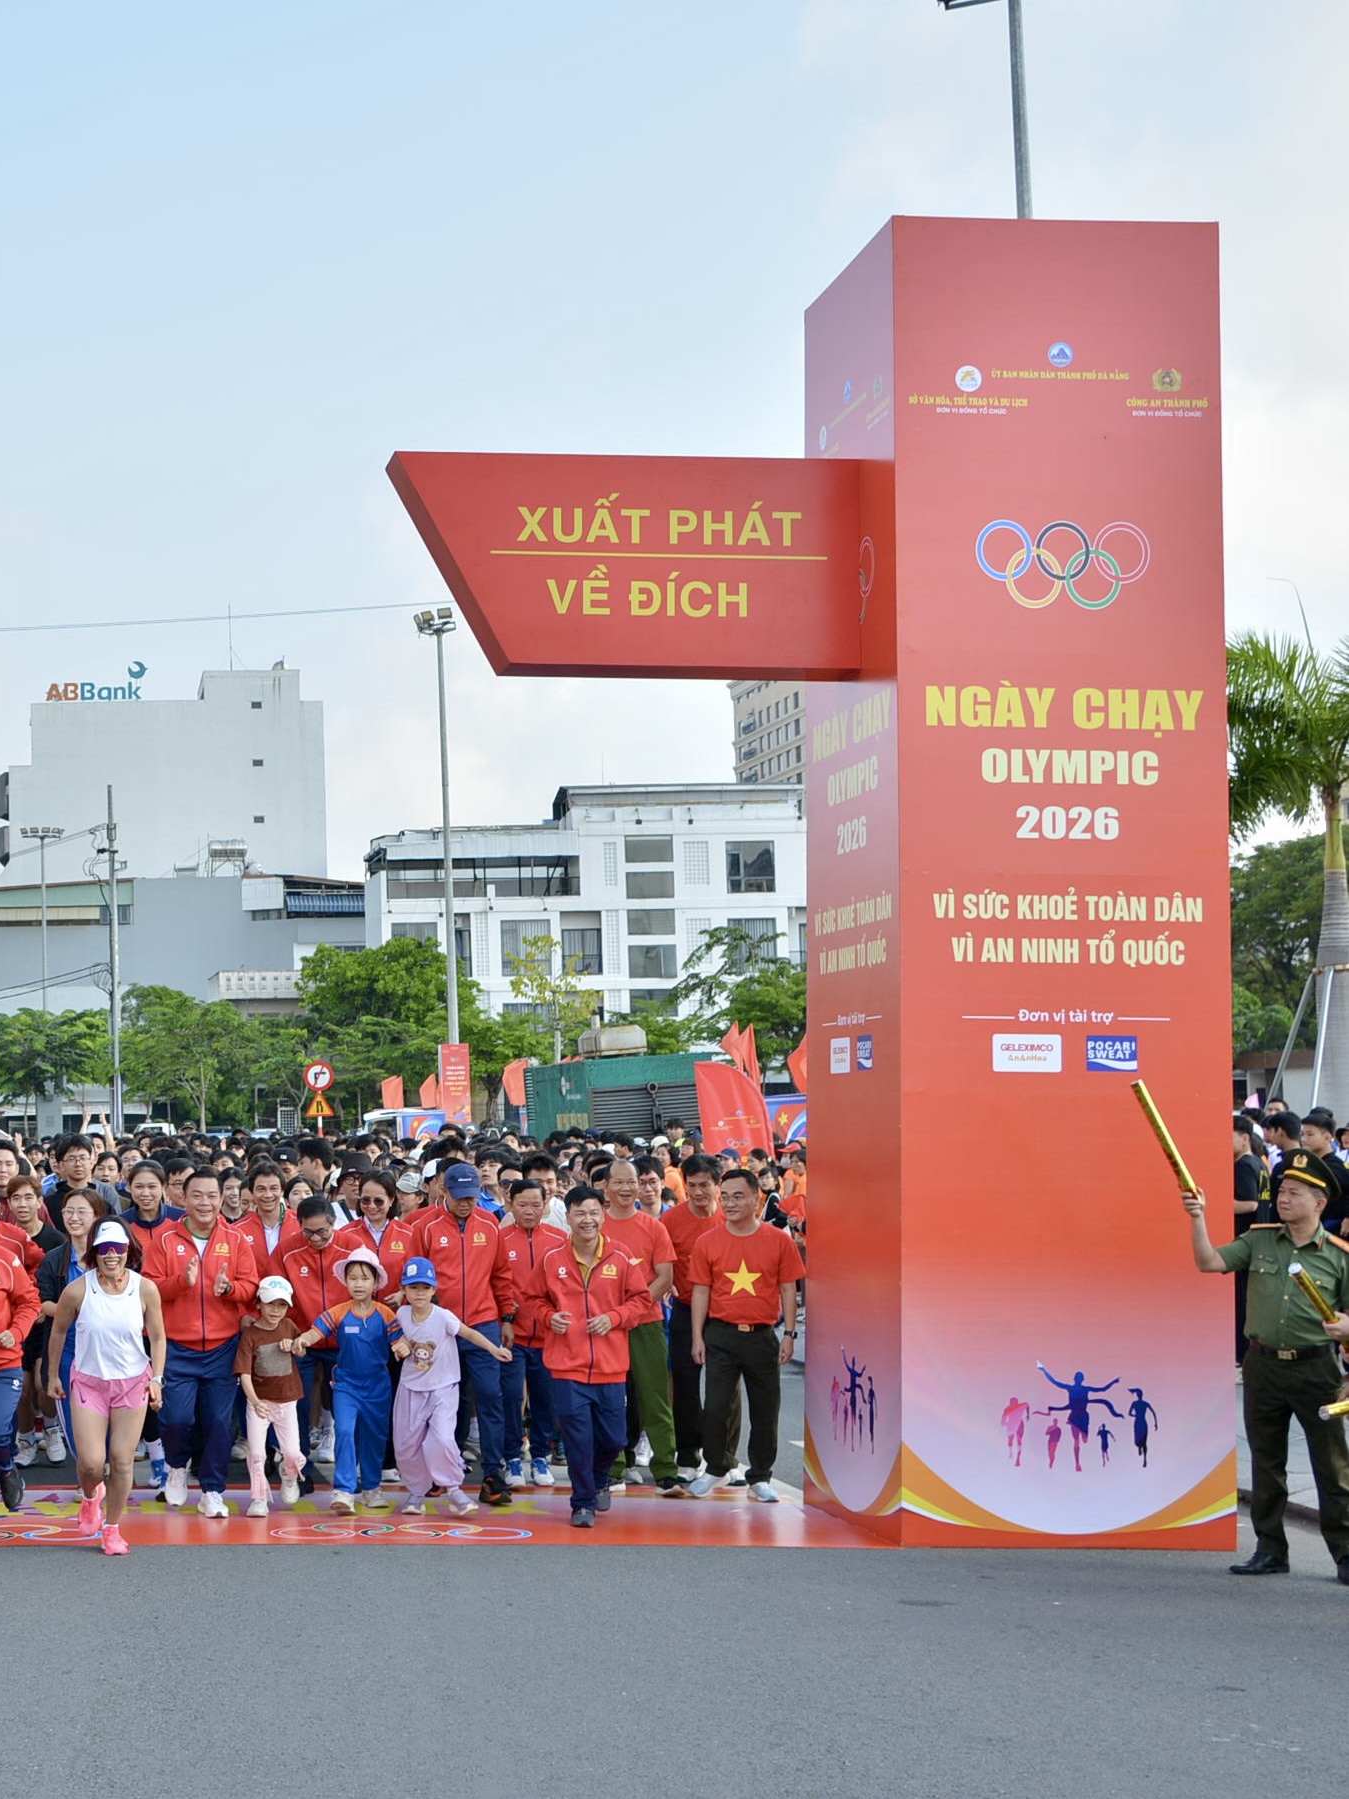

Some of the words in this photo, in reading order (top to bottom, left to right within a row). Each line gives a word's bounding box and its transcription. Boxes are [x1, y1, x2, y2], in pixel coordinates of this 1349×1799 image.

[516, 493, 651, 544] XUẤT
[669, 501, 802, 547] PHÁT
[546, 564, 611, 615] VỀ
[628, 571, 749, 618] ĐÍCH
[46, 681, 142, 701] ABBank
[925, 680, 1056, 728] NGÀY
[1072, 687, 1204, 738] CHẠY
[828, 755, 878, 807] OLYMPIC
[981, 747, 1159, 786] OLYMPIC
[836, 815, 867, 855] 2026
[1016, 805, 1119, 841] 2026
[933, 888, 955, 918] VÌ
[963, 888, 1010, 919] SỨC
[1017, 887, 1078, 920] KHOẺ
[1085, 890, 1147, 922] TOÀN
[1154, 892, 1203, 922] DÂN
[951, 932, 974, 962] VÌ
[981, 937, 1014, 963] AN
[1021, 938, 1079, 964] NINH
[1086, 929, 1116, 965] TỔ
[1122, 931, 1185, 968] QUỐC
[1018, 1009, 1049, 1022] Đơn
[1053, 1009, 1066, 1025] vị
[1068, 1009, 1087, 1022] tài
[1091, 1011, 1114, 1025] trợ
[1000, 1044, 1054, 1052] GELEXIMCO
[1087, 1041, 1136, 1051] POCARI
[1087, 1050, 1131, 1059] SWEAT
